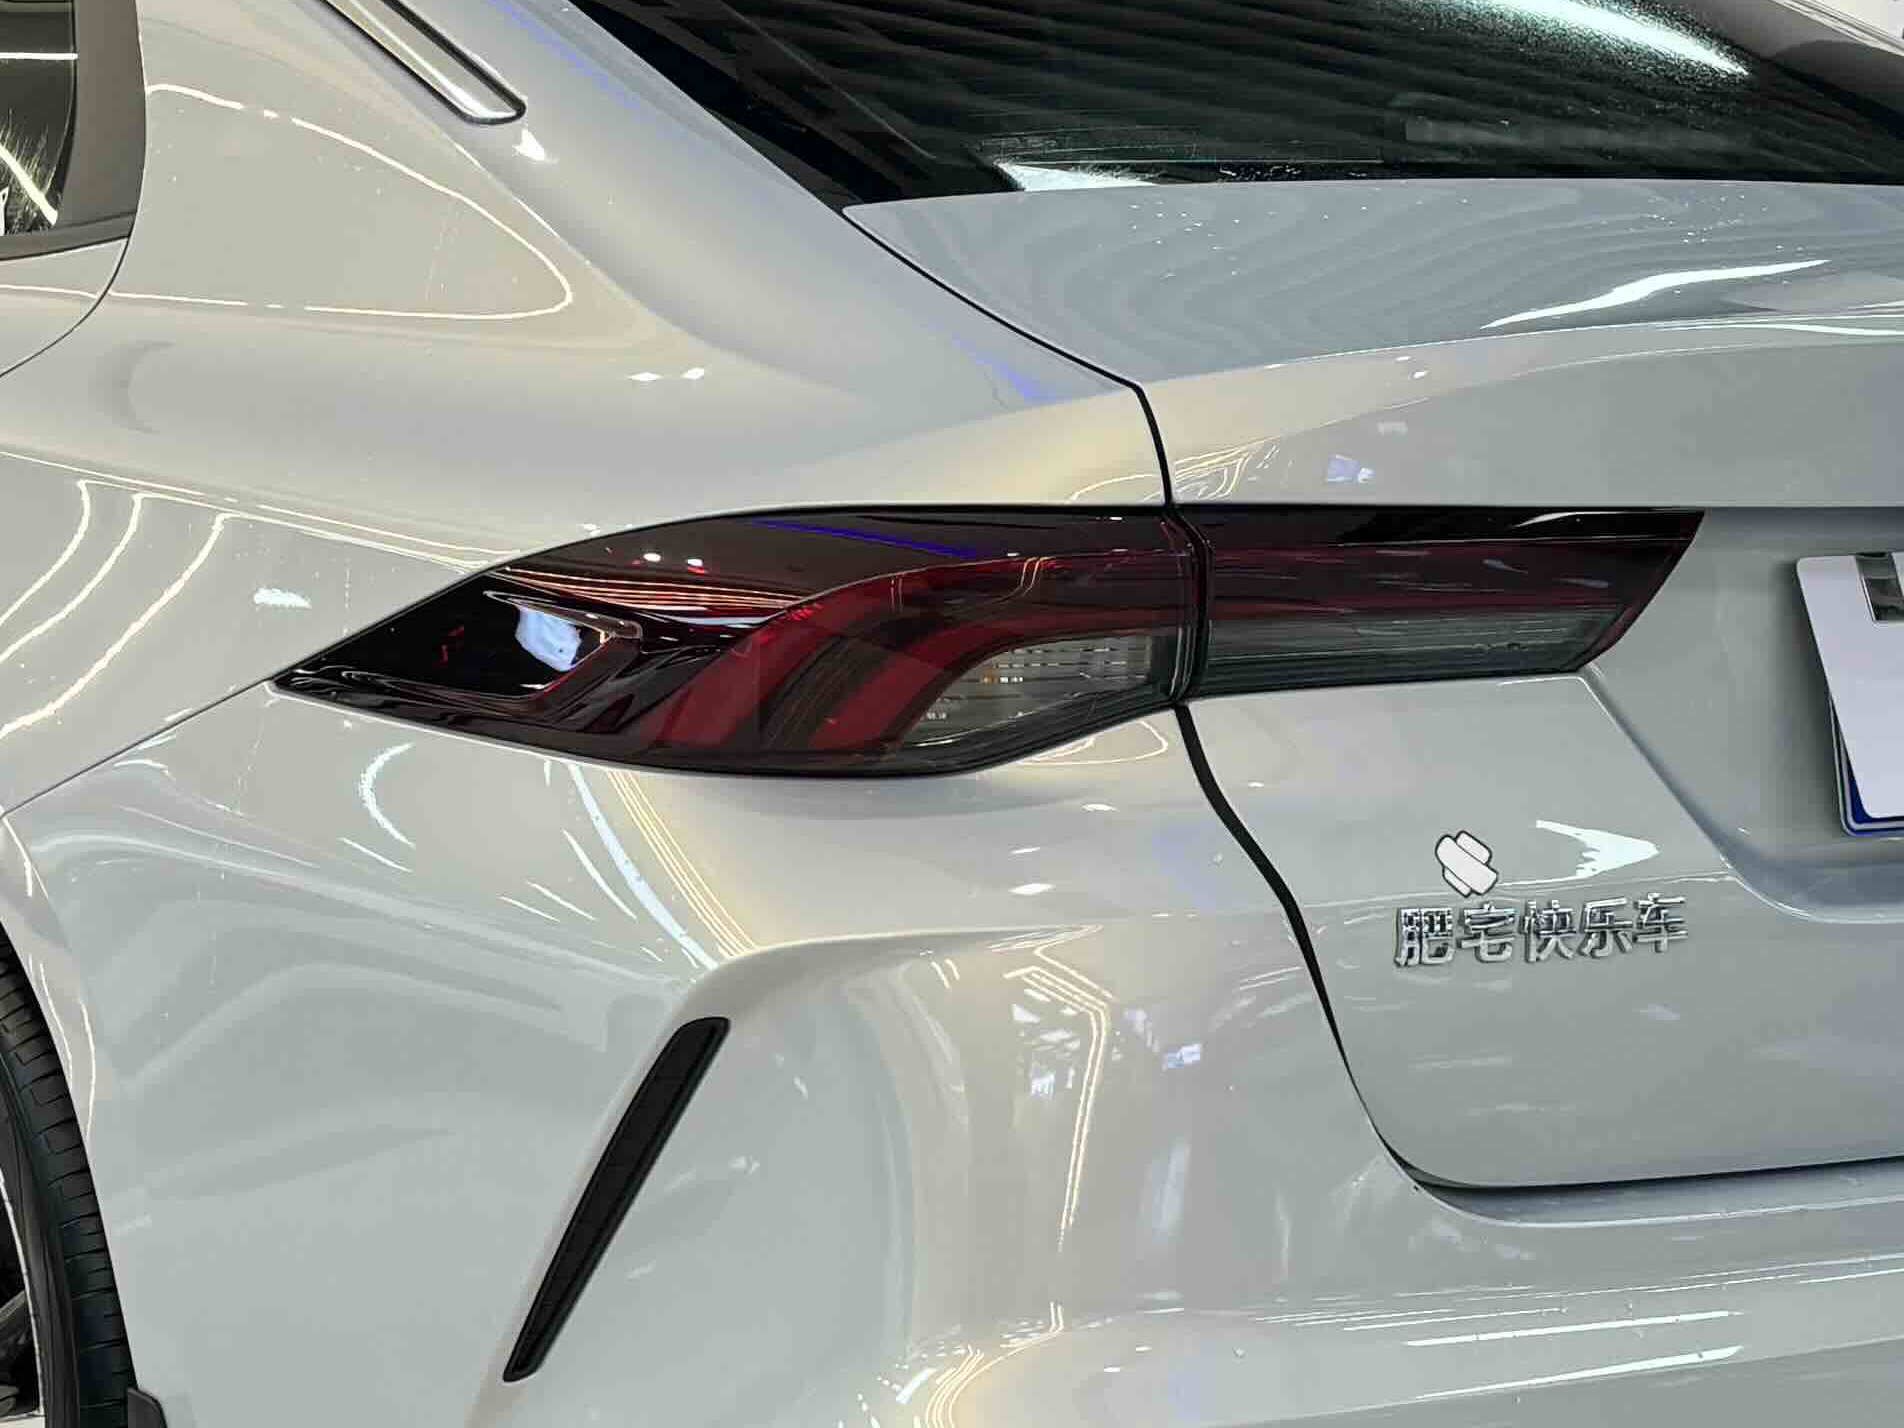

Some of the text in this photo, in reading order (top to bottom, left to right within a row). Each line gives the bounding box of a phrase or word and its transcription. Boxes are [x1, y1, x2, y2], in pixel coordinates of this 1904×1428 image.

[1394, 891, 1689, 966] 肥宅快乐车
